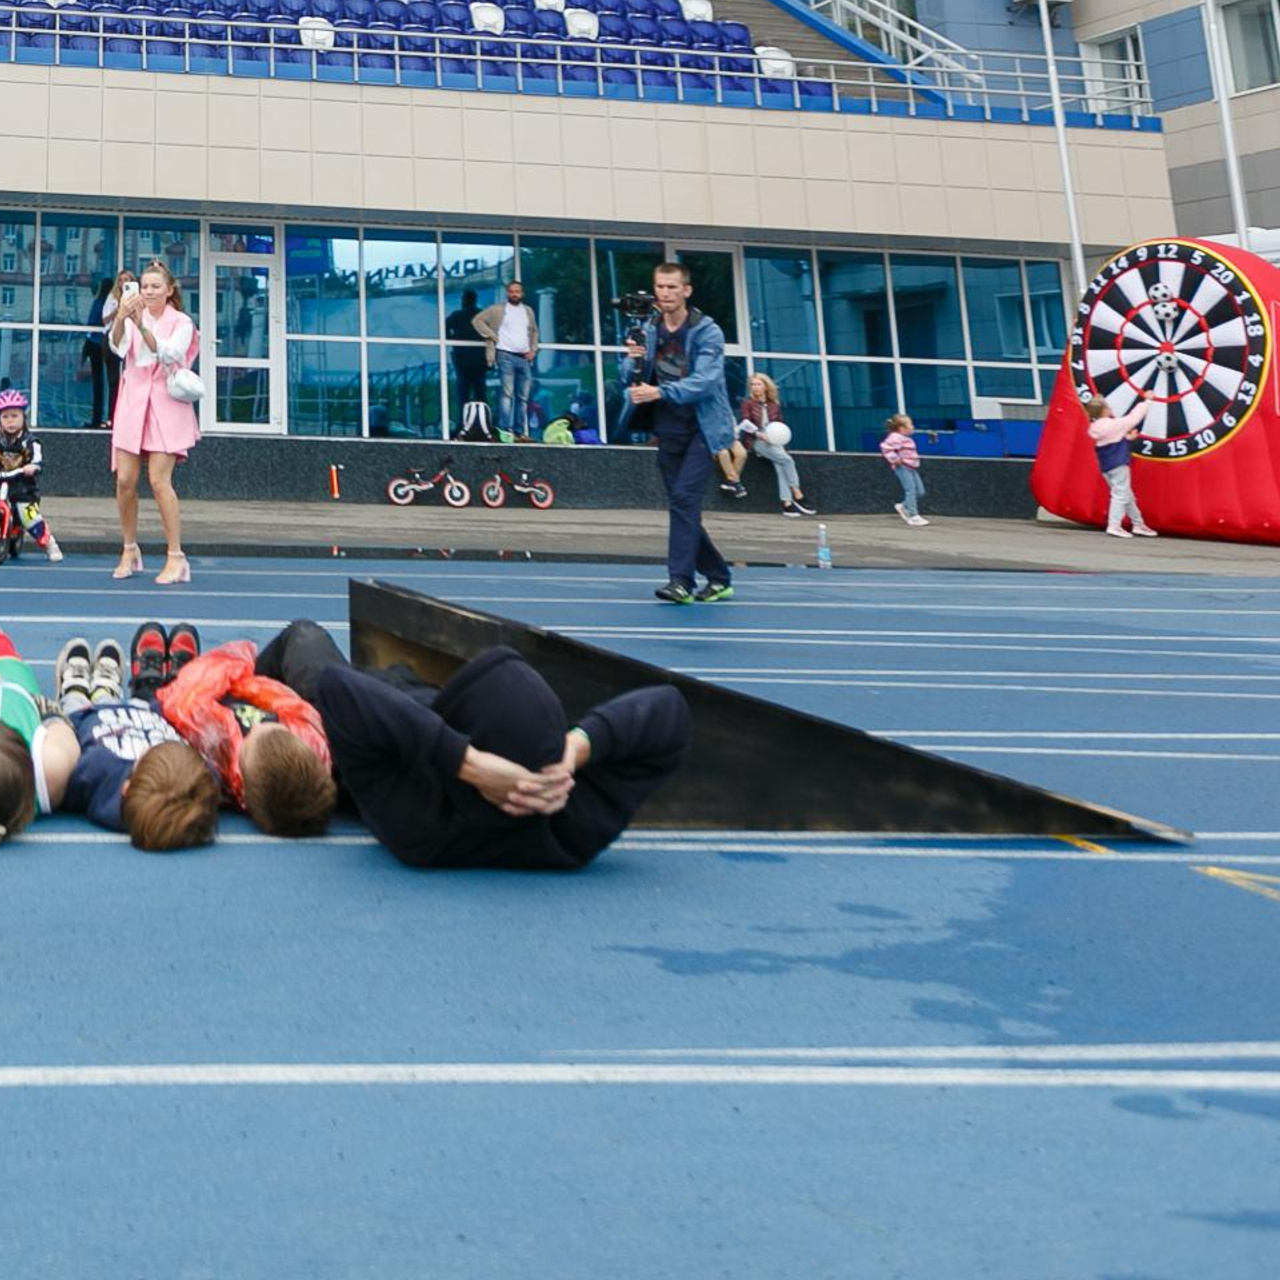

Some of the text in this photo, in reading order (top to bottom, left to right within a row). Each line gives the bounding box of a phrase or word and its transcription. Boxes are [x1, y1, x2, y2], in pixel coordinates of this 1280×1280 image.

[1136, 247, 1148, 261] 9
[1157, 244, 1179, 258] 12
[1190, 251, 1206, 266] 5
[1109, 256, 1129, 275] 14
[1210, 262, 1235, 284] 20
[1089, 273, 1108, 294] 11
[1234, 290, 1251, 305] 1
[1244, 312, 1264, 338] 18
[1071, 326, 1084, 346] 16
[1248, 354, 1264, 367] 4
[1237, 381, 1257, 406] 13
[1222, 412, 1237, 428] 6
[1142, 440, 1153, 455] 2
[1168, 439, 1188, 456] 15
[1194, 428, 1216, 450] 10
